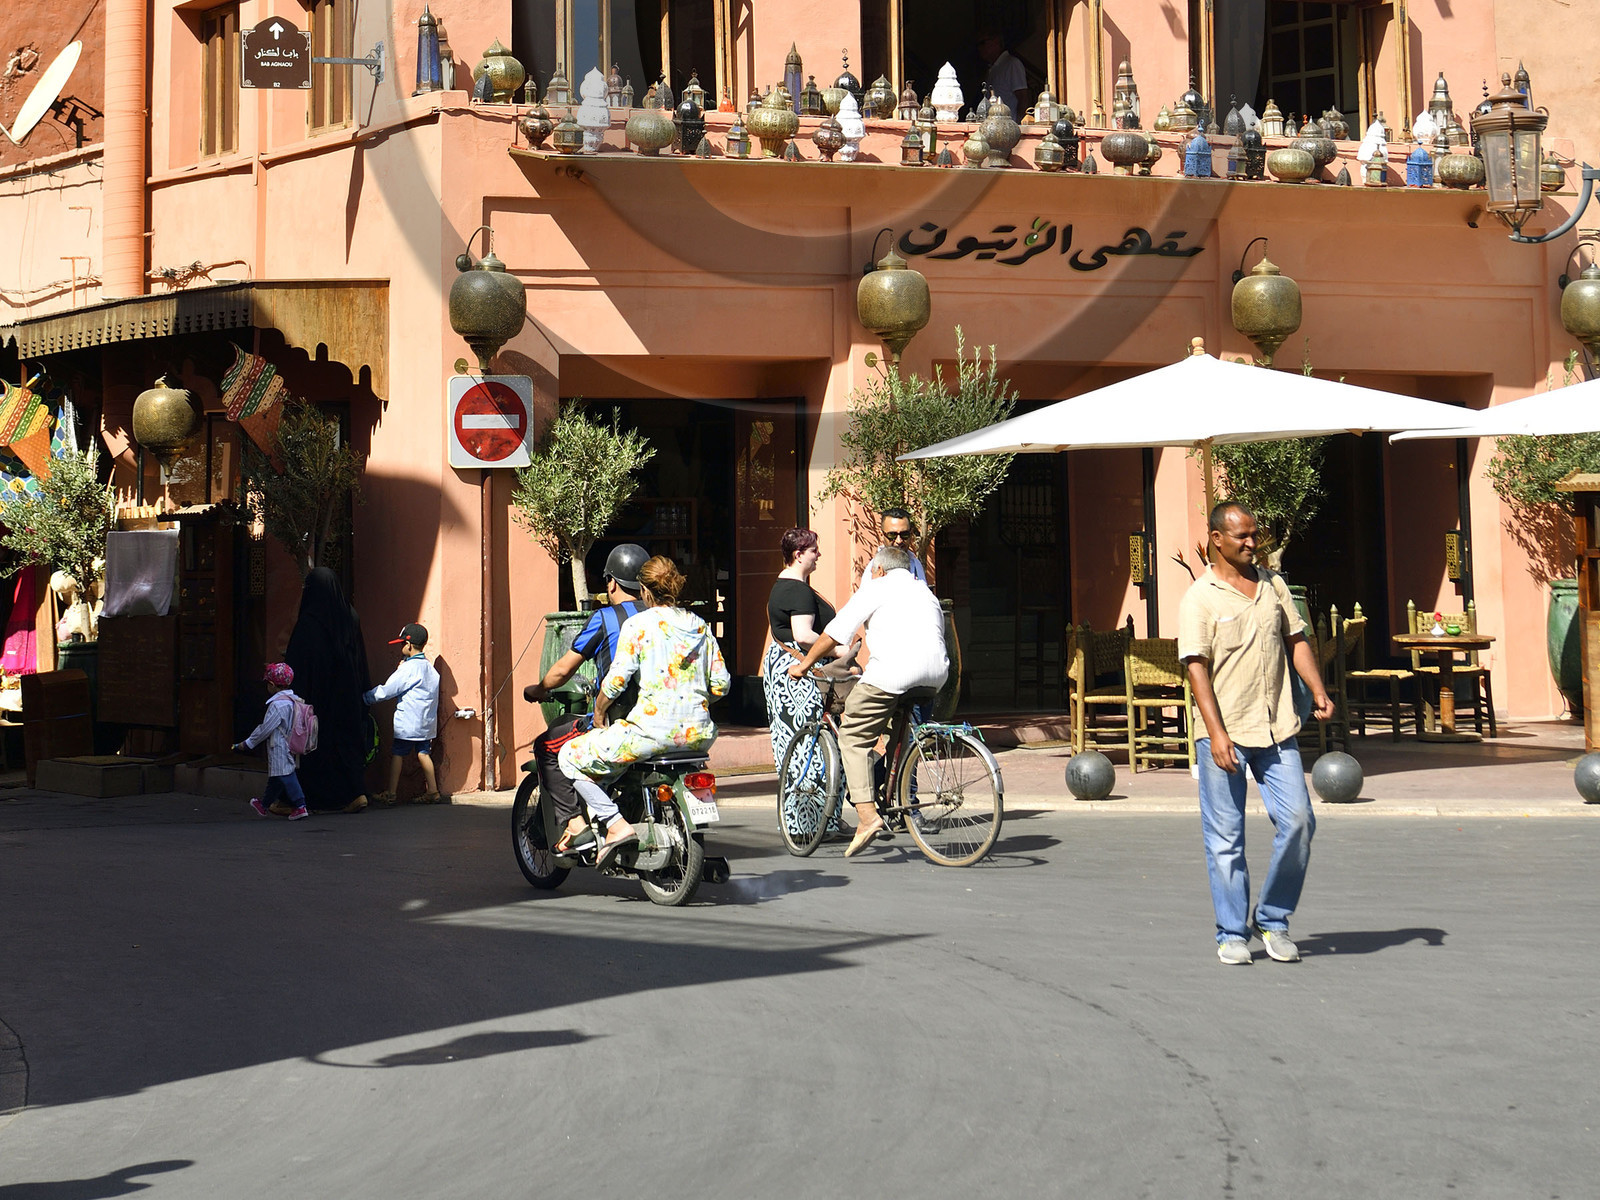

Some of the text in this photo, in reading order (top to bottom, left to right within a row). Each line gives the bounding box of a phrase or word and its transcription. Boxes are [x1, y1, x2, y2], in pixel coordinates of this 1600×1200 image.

[282, 48, 299, 59] باب
[898, 217, 1206, 272] مقهى الزيتون
